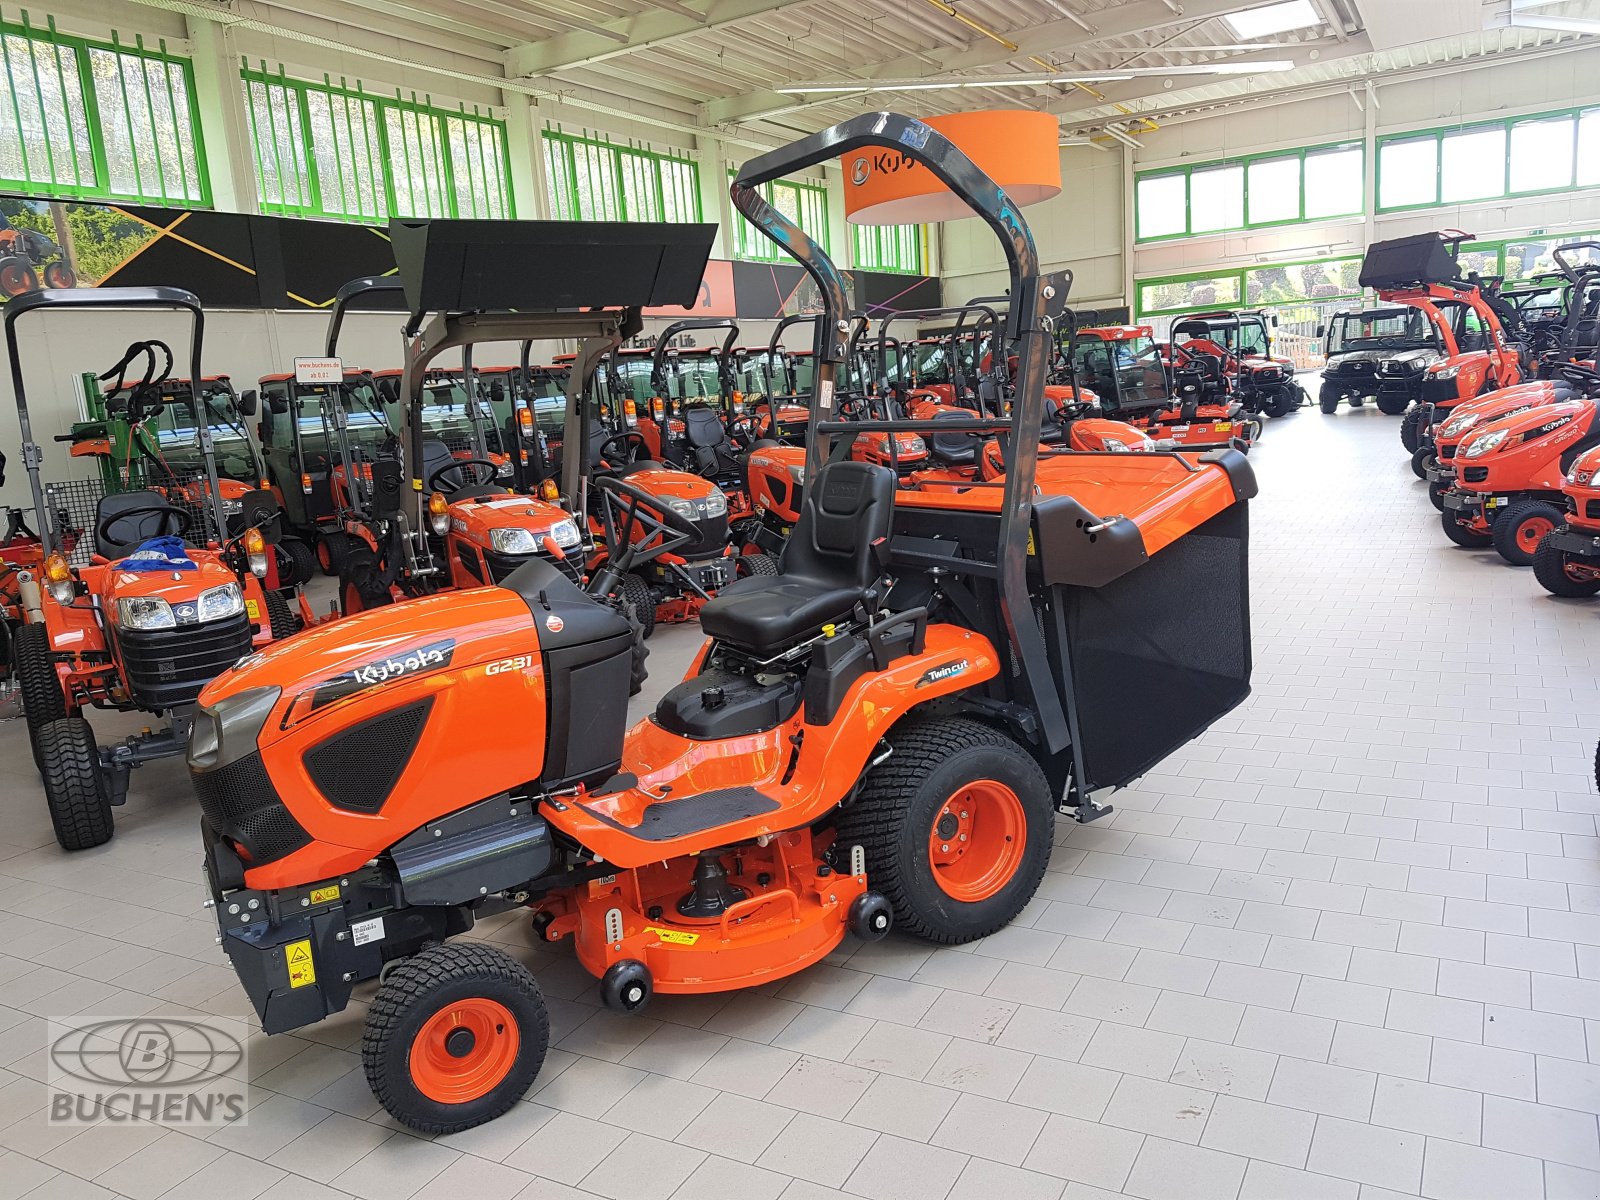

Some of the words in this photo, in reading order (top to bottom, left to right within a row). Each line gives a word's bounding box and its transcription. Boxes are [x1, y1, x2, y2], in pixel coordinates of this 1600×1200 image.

[680, 334, 697, 348] Life
[297, 361, 340, 369] www.buchens.de
[1504, 406, 1530, 418] Kubota
[1541, 417, 1571, 431] Kubota
[353, 649, 444, 684] Kubota
[485, 655, 532, 676] G231
